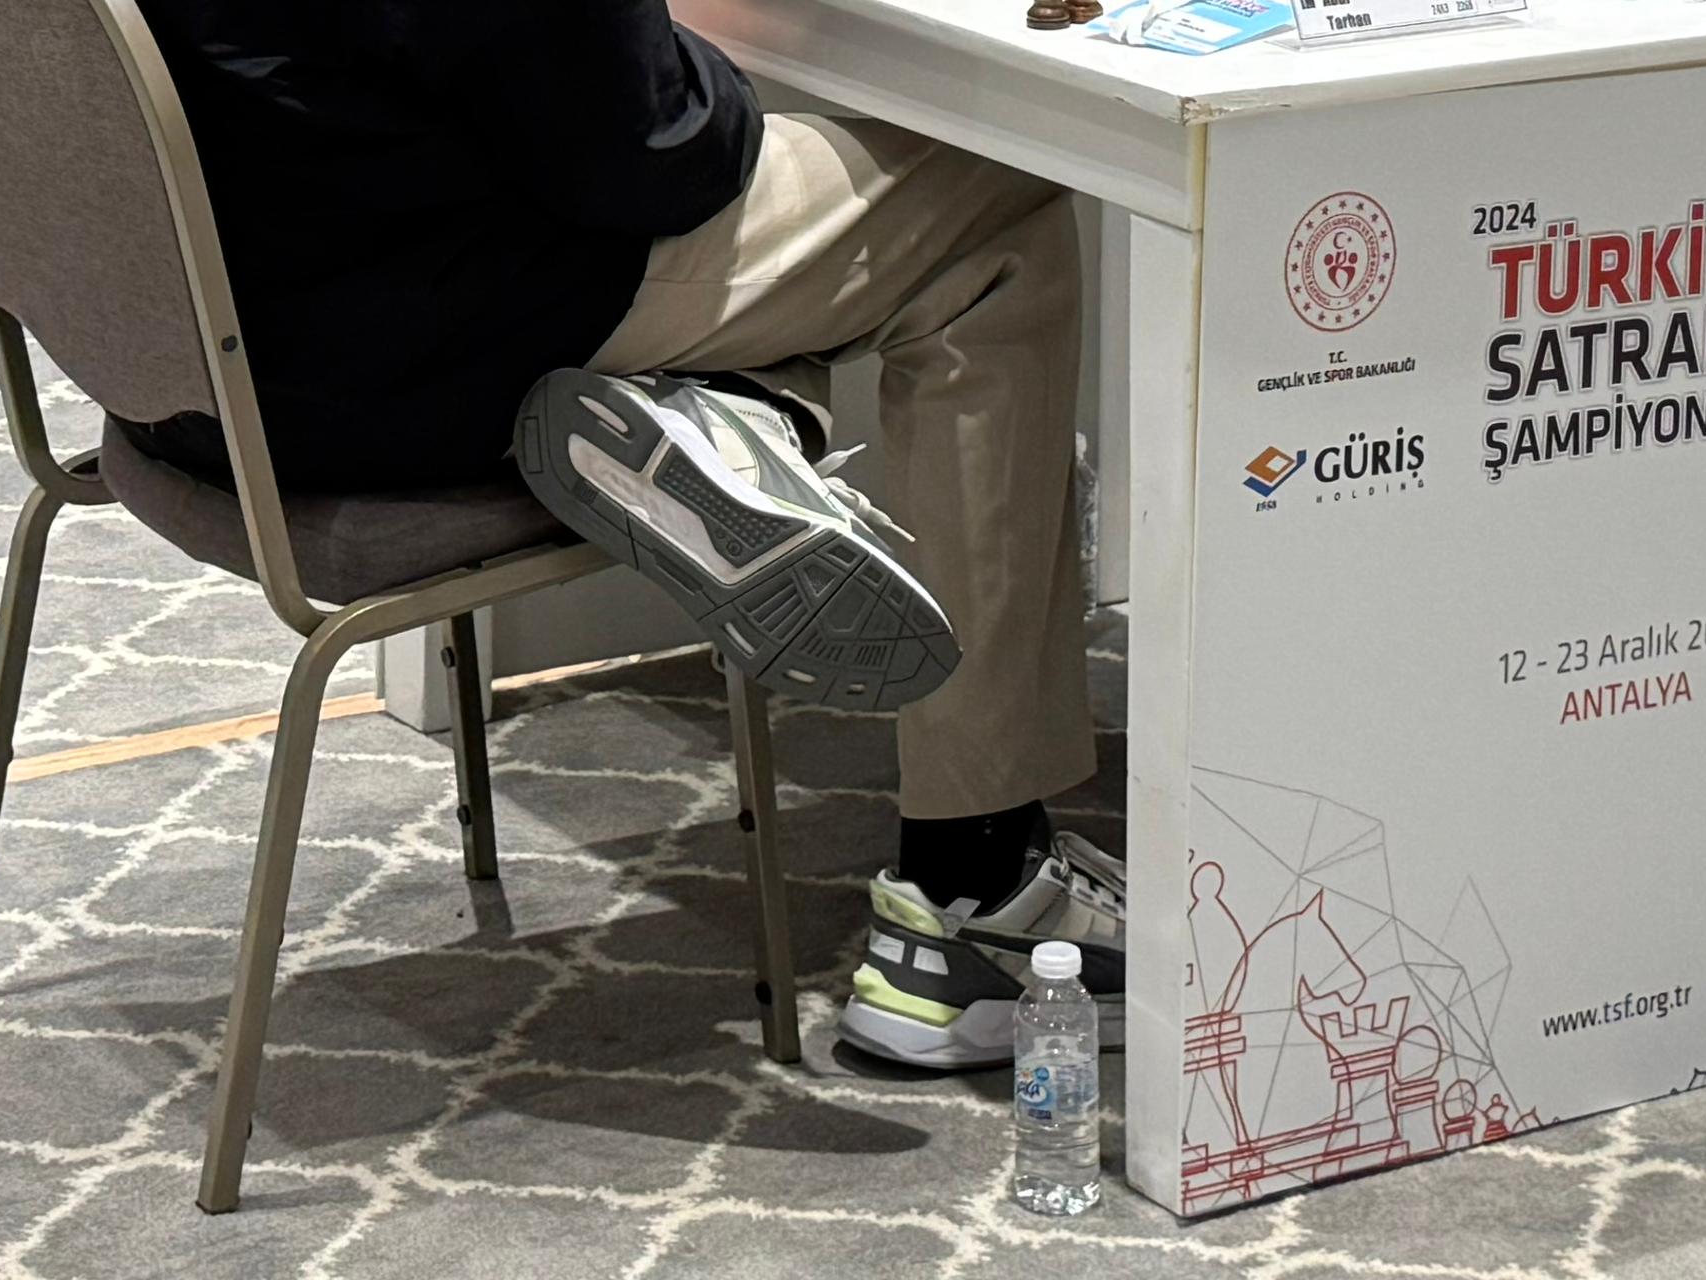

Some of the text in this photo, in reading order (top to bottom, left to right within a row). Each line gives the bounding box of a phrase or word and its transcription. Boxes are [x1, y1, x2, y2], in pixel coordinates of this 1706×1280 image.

[1473, 202, 1537, 235] 2024
[1257, 357, 1416, 392] GENÇLİK VE SPOR BAKANLIĞI
[1329, 351, 1347, 365] T.C.
[1314, 426, 1424, 483] GÜRİŞ
[1499, 650, 1527, 684] 12
[1557, 639, 1589, 674] 23
[1598, 622, 1678, 667] Aralık
[1560, 671, 1692, 725] ANTALYA
[1543, 986, 1692, 1037] www.tsf.org.tr
